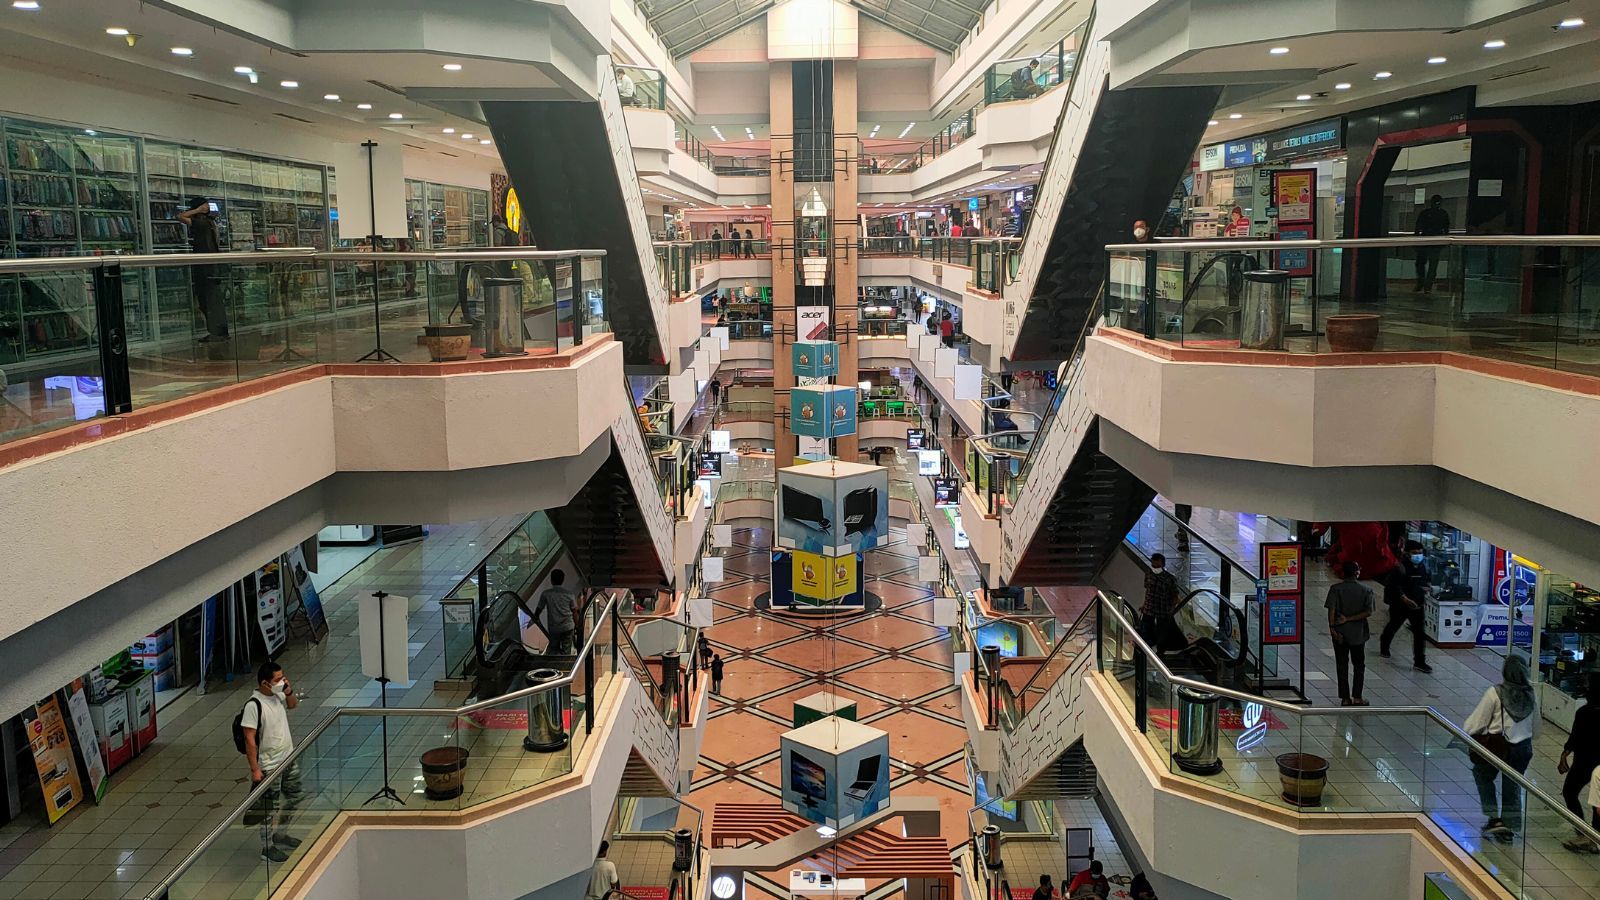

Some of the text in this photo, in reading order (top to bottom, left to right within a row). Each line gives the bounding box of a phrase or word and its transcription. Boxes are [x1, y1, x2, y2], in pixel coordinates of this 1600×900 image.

[1206, 148, 1218, 158] EPSON
[801, 311, 824, 319] acer
[714, 877, 735, 898] hp
